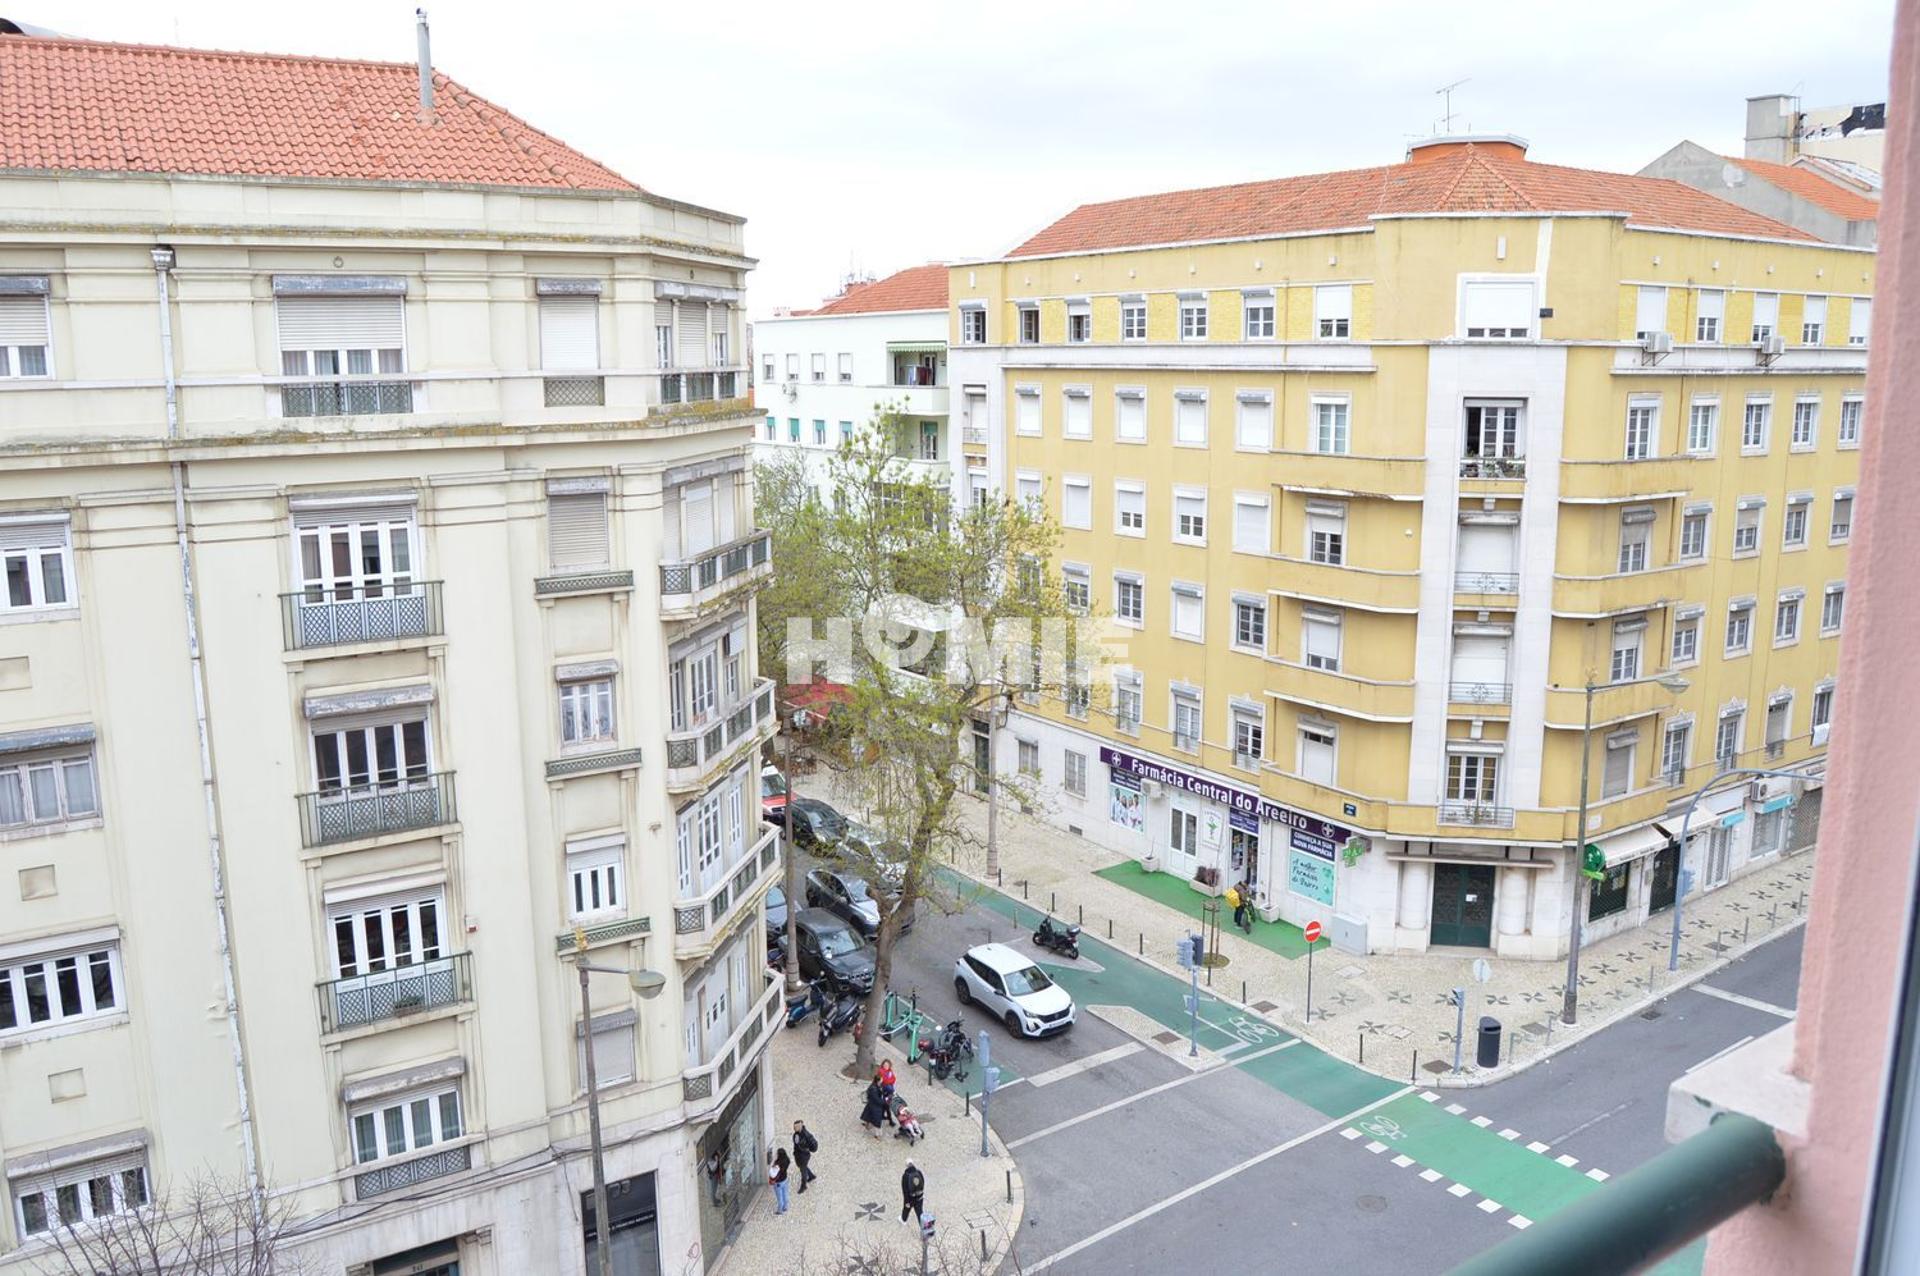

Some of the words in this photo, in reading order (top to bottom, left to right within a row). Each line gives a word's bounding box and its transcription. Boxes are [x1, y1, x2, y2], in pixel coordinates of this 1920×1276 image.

[1132, 759, 1184, 787] Farmácia
[1187, 777, 1232, 804] Central
[1235, 793, 1252, 811] do
[1255, 797, 1307, 829] Areeiro
